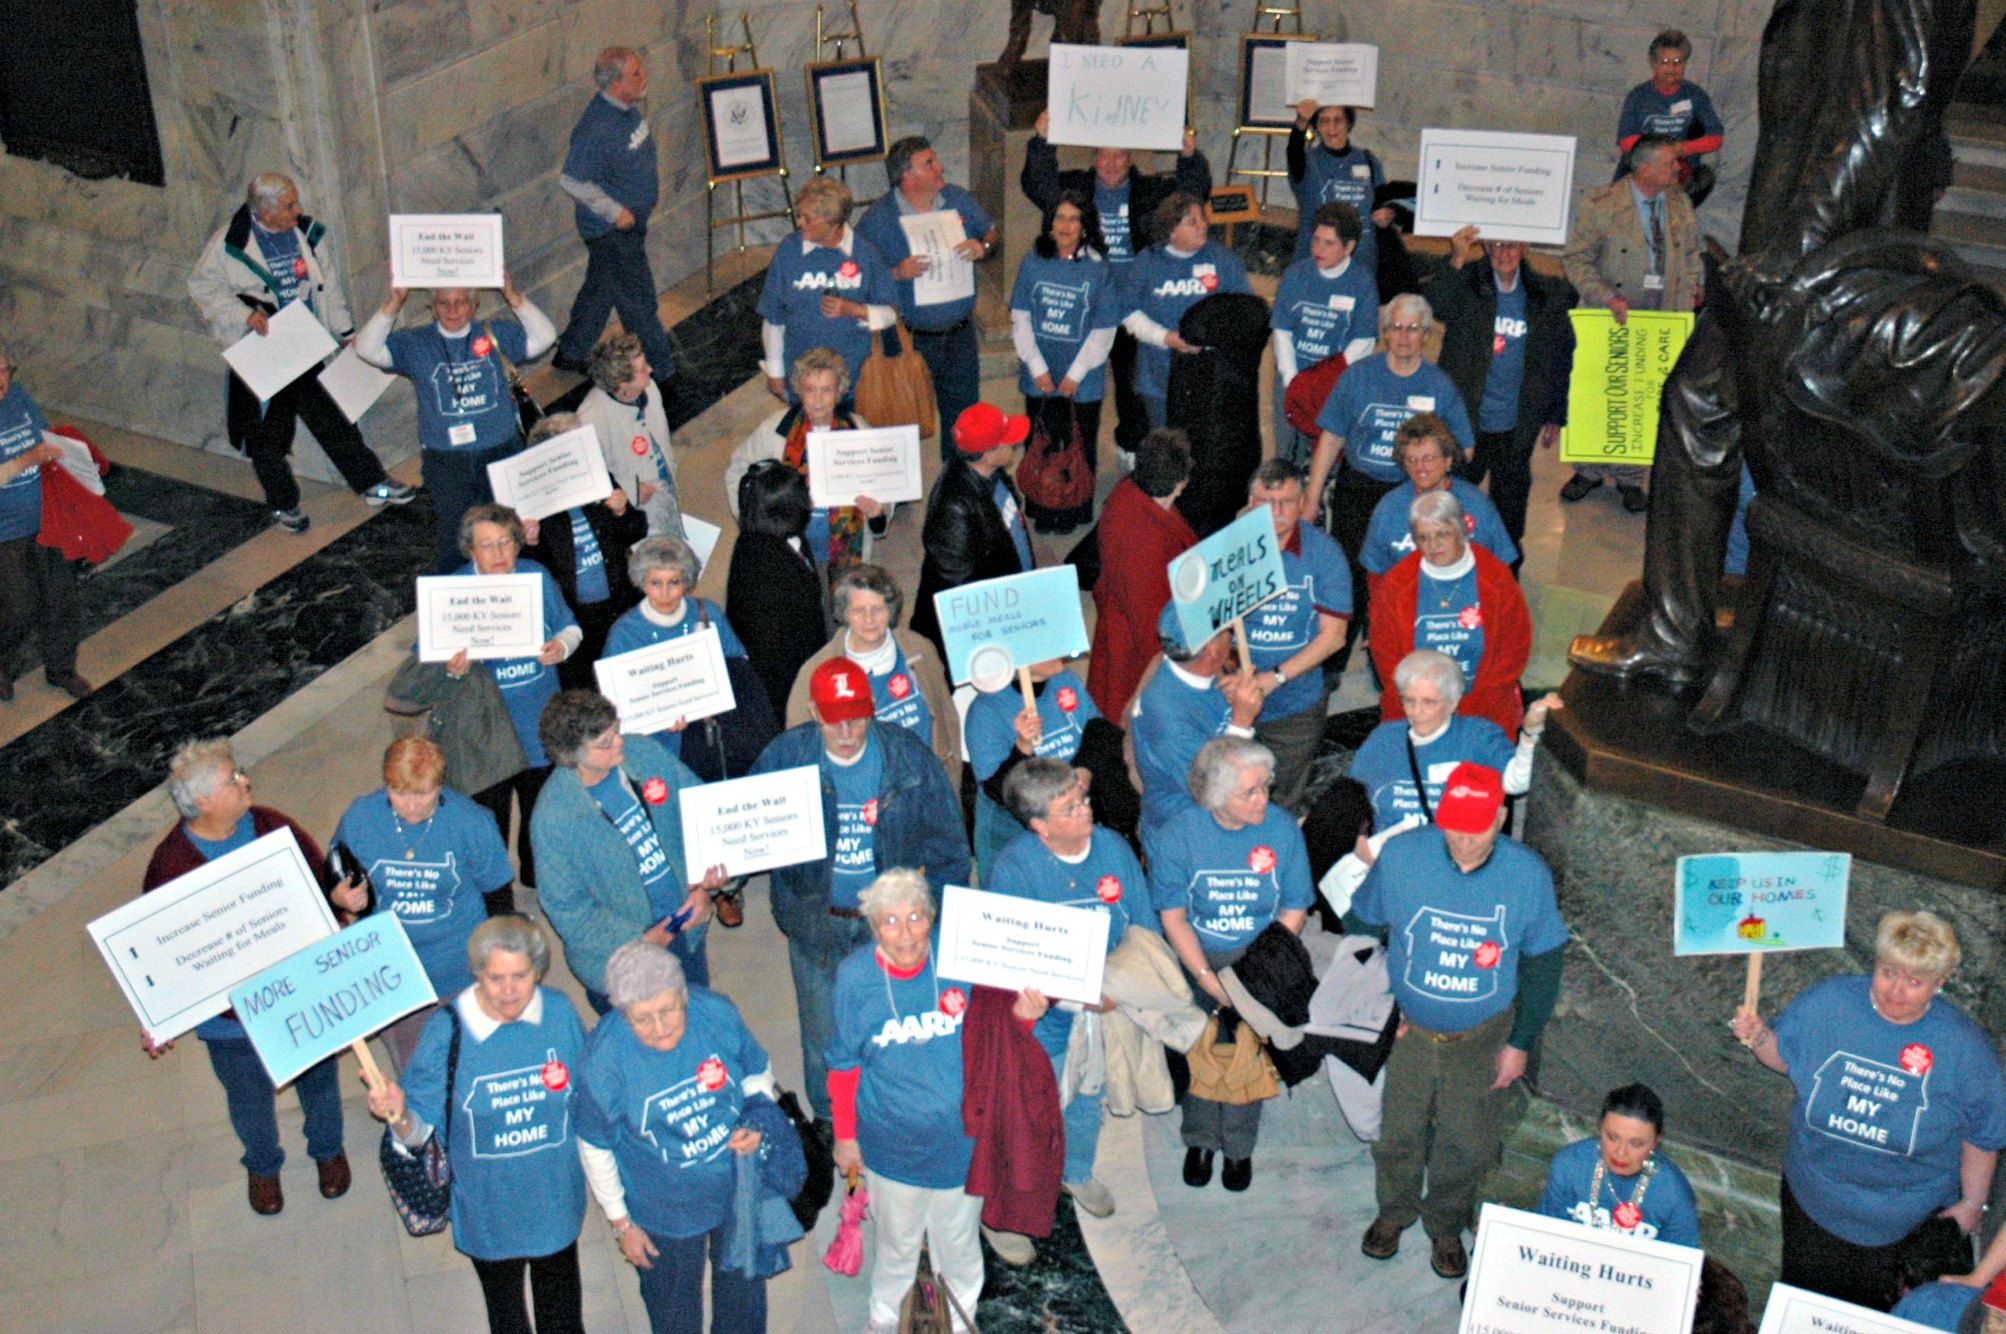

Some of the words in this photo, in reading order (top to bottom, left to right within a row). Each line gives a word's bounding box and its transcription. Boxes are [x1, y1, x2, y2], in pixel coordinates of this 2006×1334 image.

[1141, 54, 1157, 72] A
[1153, 278, 1208, 297] AAR
[1046, 307, 1066, 320] MY
[1306, 327, 1326, 340] MY
[1658, 327, 1672, 363] CARE
[1297, 339, 1330, 356] HOME
[1634, 328, 1647, 383] FUNDING
[1603, 374, 1628, 397] OUR
[1602, 399, 1628, 455] SUPPORT
[1631, 388, 1644, 452] INCREASE
[449, 597, 470, 606] End
[472, 596, 487, 605] the
[489, 595, 512, 604] Wait
[951, 587, 1019, 618] FUND
[1208, 570, 1277, 629] WHEELS
[1279, 602, 1298, 612] Like
[972, 629, 992, 641] FOR
[1001, 618, 1047, 635] SENIORS
[1262, 614, 1288, 627] MY
[1251, 629, 1295, 643] HOME
[496, 662, 536, 680] HOME
[628, 661, 666, 677] Waiting
[666, 653, 694, 667] Hurts
[717, 804, 739, 816] End
[742, 801, 759, 811] the
[761, 795, 787, 807] Wait
[710, 820, 742, 836] 15,000
[744, 816, 761, 829] KY
[763, 812, 798, 825] Seniors
[638, 833, 659, 858] MY
[722, 834, 748, 848] Need
[750, 828, 788, 842] Services
[835, 838, 861, 852] MY
[385, 866, 423, 878] There's
[424, 869, 441, 880] No
[386, 878, 414, 890] Place
[415, 880, 438, 891] Like
[1206, 876, 1243, 888] There's
[1244, 876, 1261, 888] No
[1708, 877, 1747, 890] KEEP
[1751, 877, 1773, 889] US
[1776, 876, 1797, 887] IN
[1208, 890, 1235, 901] Place
[1236, 889, 1259, 901] Like
[1706, 891, 1743, 906] OUR
[1751, 888, 1817, 904] HOMES
[156, 917, 202, 946] Increase
[202, 901, 237, 923] Senior
[239, 877, 285, 905] Funding
[1218, 904, 1247, 917] MY
[982, 911, 1030, 930] Waiting
[1033, 921, 1069, 936] Hurts
[1205, 916, 1255, 932] HOME
[1430, 915, 1470, 935] There's
[1470, 924, 1488, 937] No
[174, 937, 225, 967] Decrease
[225, 931, 233, 941] #
[235, 922, 249, 936] of
[249, 905, 290, 929] Seniors
[191, 944, 237, 973] Waiting
[236, 937, 252, 951] for
[252, 920, 288, 942] Meals
[1430, 931, 1459, 948] Place
[1439, 950, 1470, 970] MY
[243, 976, 298, 1023] MORE
[315, 930, 383, 975] SENIOR
[1424, 970, 1480, 993] HOME
[284, 964, 404, 1048] FUNDING
[487, 1077, 528, 1094] There's
[1844, 1060, 1886, 1082] There's
[1886, 1074, 1907, 1089] No
[491, 1094, 521, 1111] Place
[522, 1089, 547, 1103] Like
[658, 1086, 698, 1111] There's
[1840, 1075, 1872, 1094] Place
[1872, 1085, 1900, 1102] Like
[505, 1105, 535, 1126] MY
[666, 1104, 693, 1125] Place
[1846, 1094, 1882, 1118] MY
[494, 1124, 549, 1148] HOME
[682, 1113, 709, 1138] MY
[1828, 1113, 1890, 1145] HOME
[681, 1123, 731, 1159] HOME
[1518, 1245, 1592, 1279] Waiting
[1597, 1263, 1654, 1290] Hurts
[1497, 1295, 1539, 1315] Senior
[1542, 1306, 1597, 1329] Services
[1551, 1291, 1606, 1314] Support
